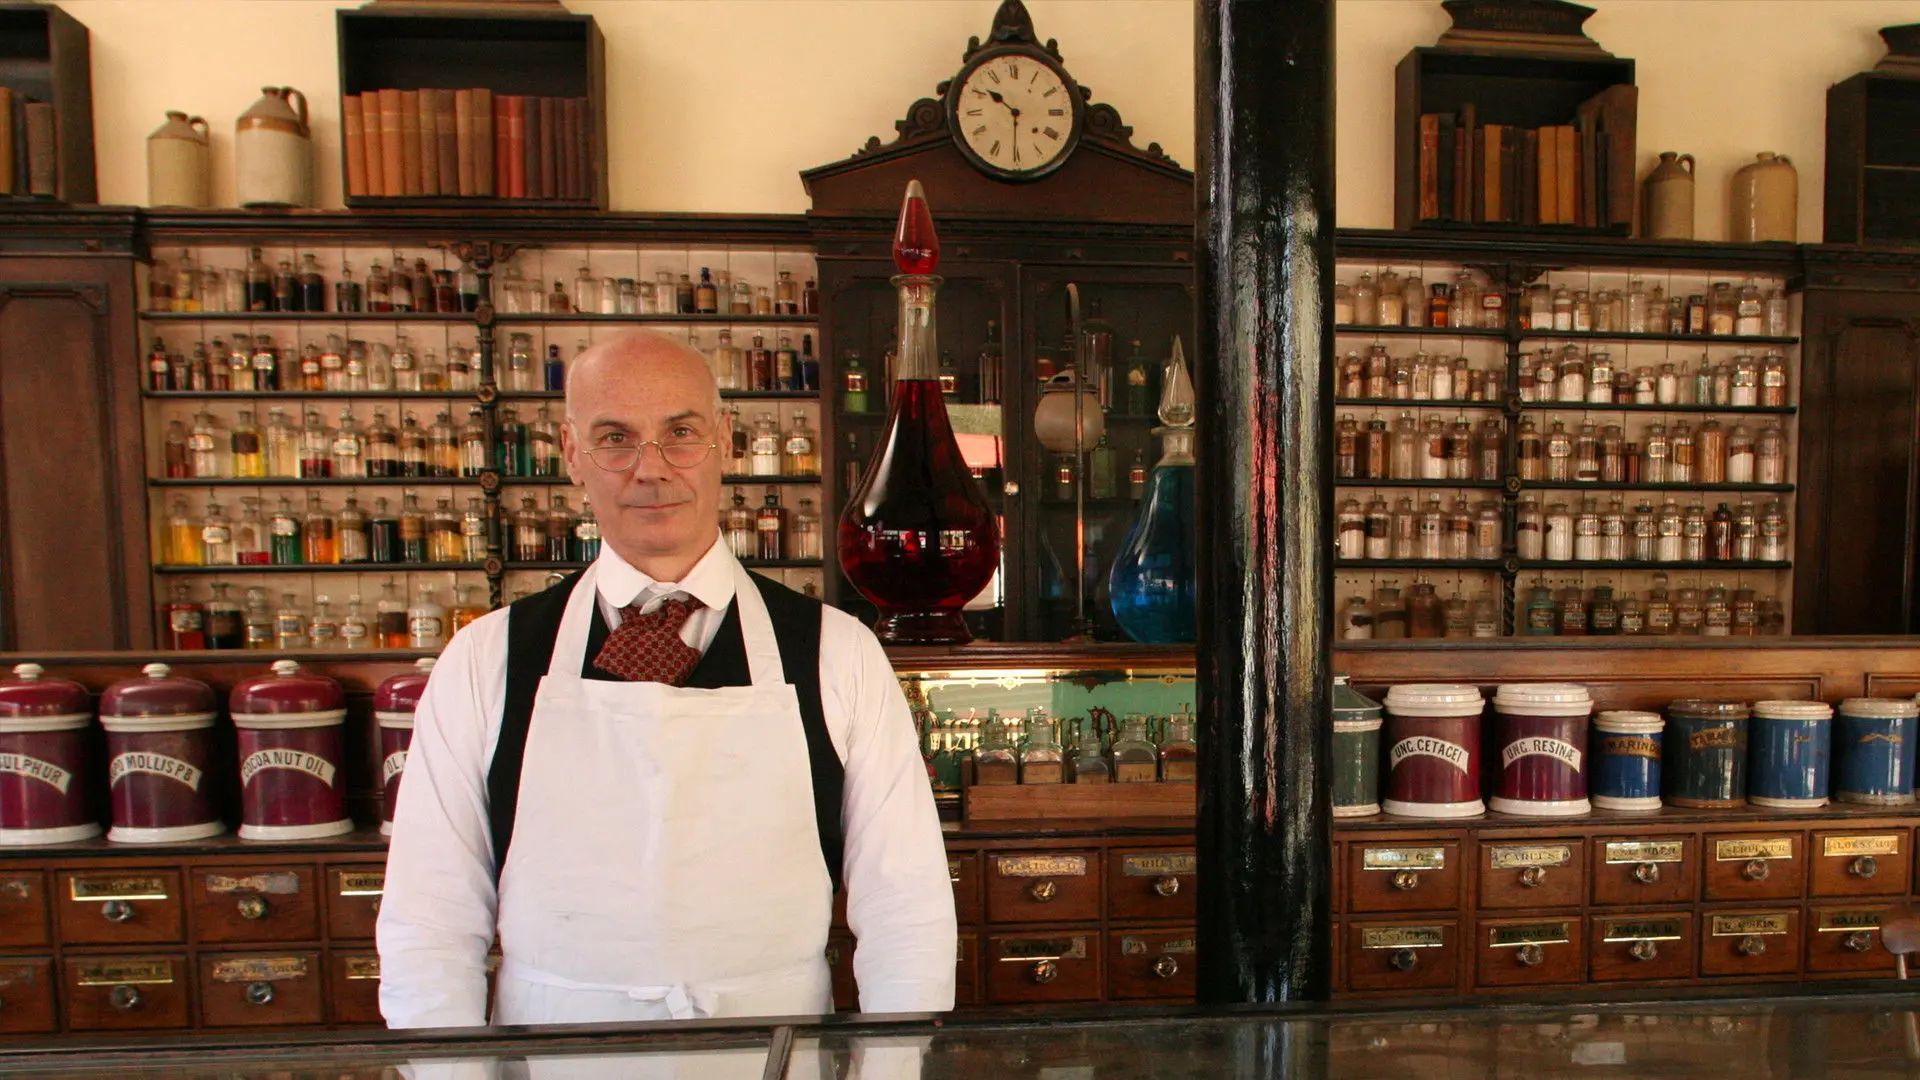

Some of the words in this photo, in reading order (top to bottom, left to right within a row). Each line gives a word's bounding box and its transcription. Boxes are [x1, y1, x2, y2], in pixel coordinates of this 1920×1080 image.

[1417, 739, 1462, 762] CETACEI
[0, 756, 65, 784] ULPHUR
[273, 752, 303, 767] NUT
[305, 757, 326, 777] OIL
